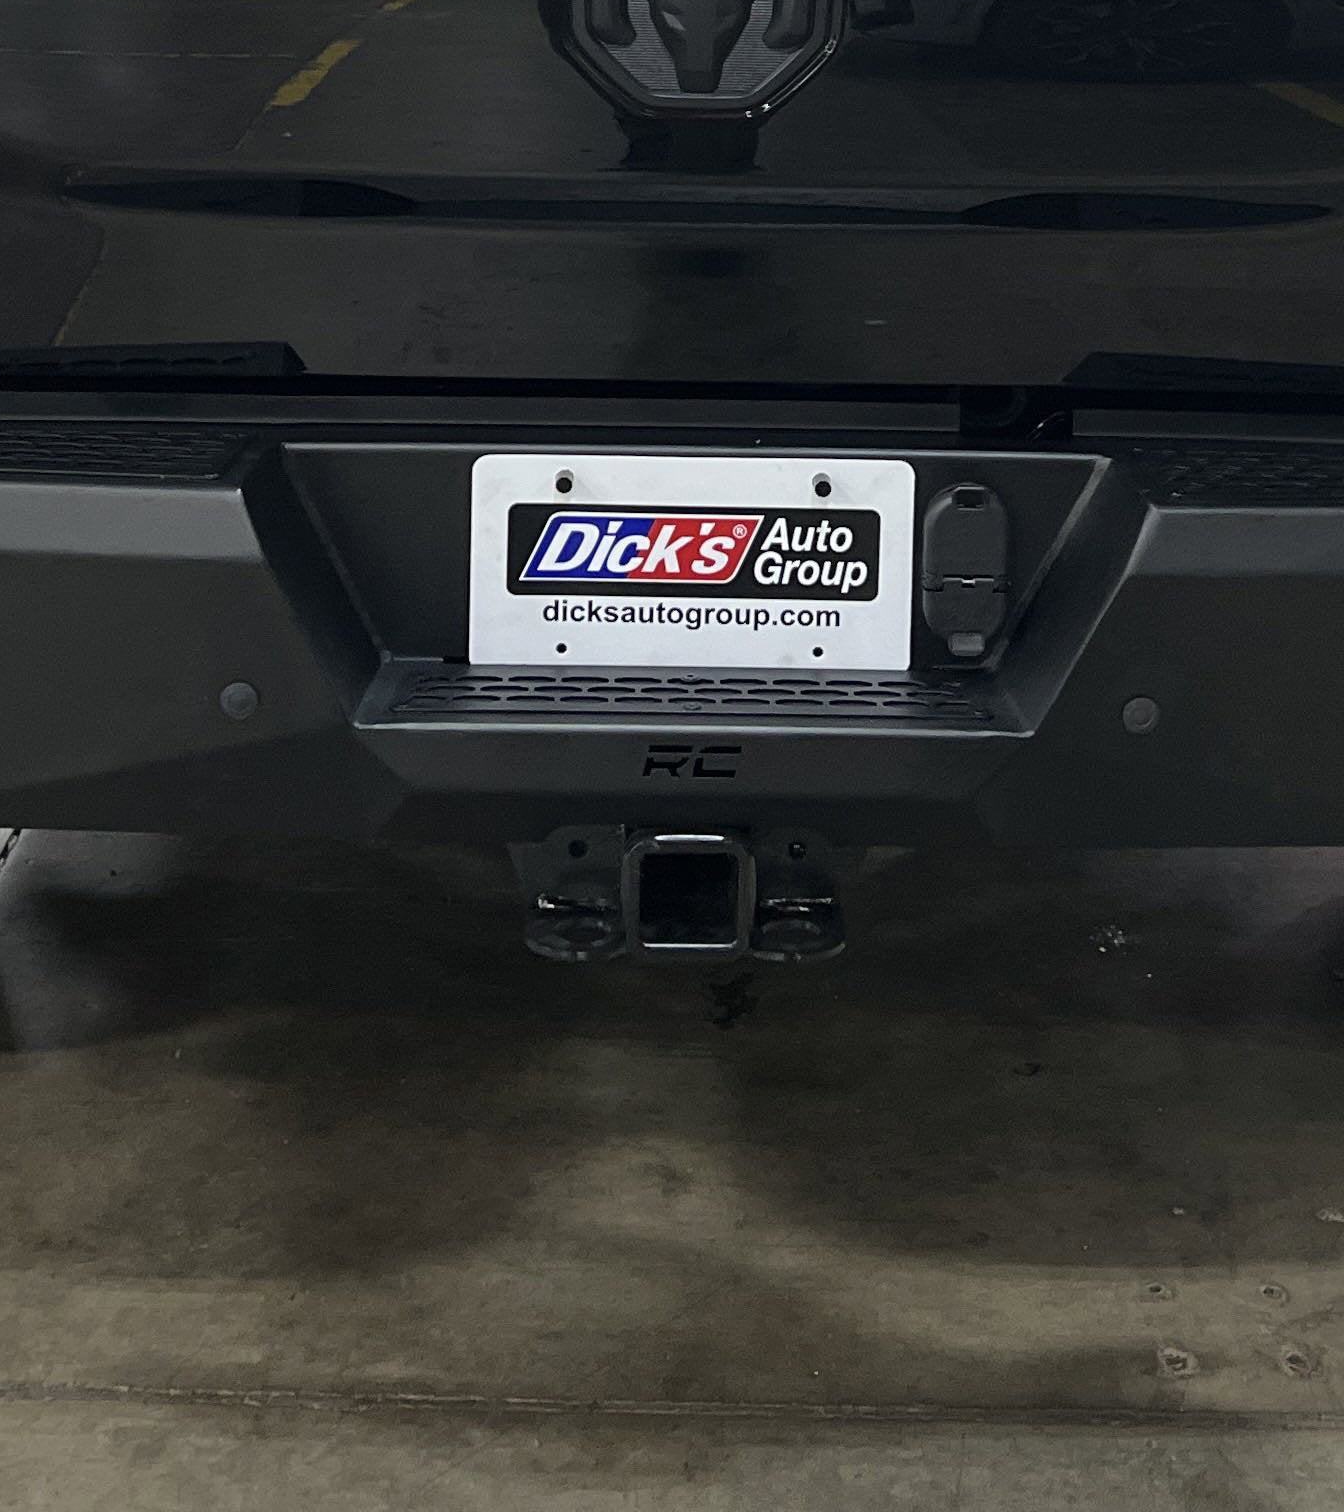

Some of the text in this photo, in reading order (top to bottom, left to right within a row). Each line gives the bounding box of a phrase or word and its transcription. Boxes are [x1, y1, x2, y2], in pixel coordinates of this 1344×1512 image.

[536, 518, 737, 576] Dick's
[760, 519, 853, 553] Auto
[754, 551, 868, 594] Group
[542, 600, 841, 631] dicksautogroup.com
[642, 745, 743, 778] RC
